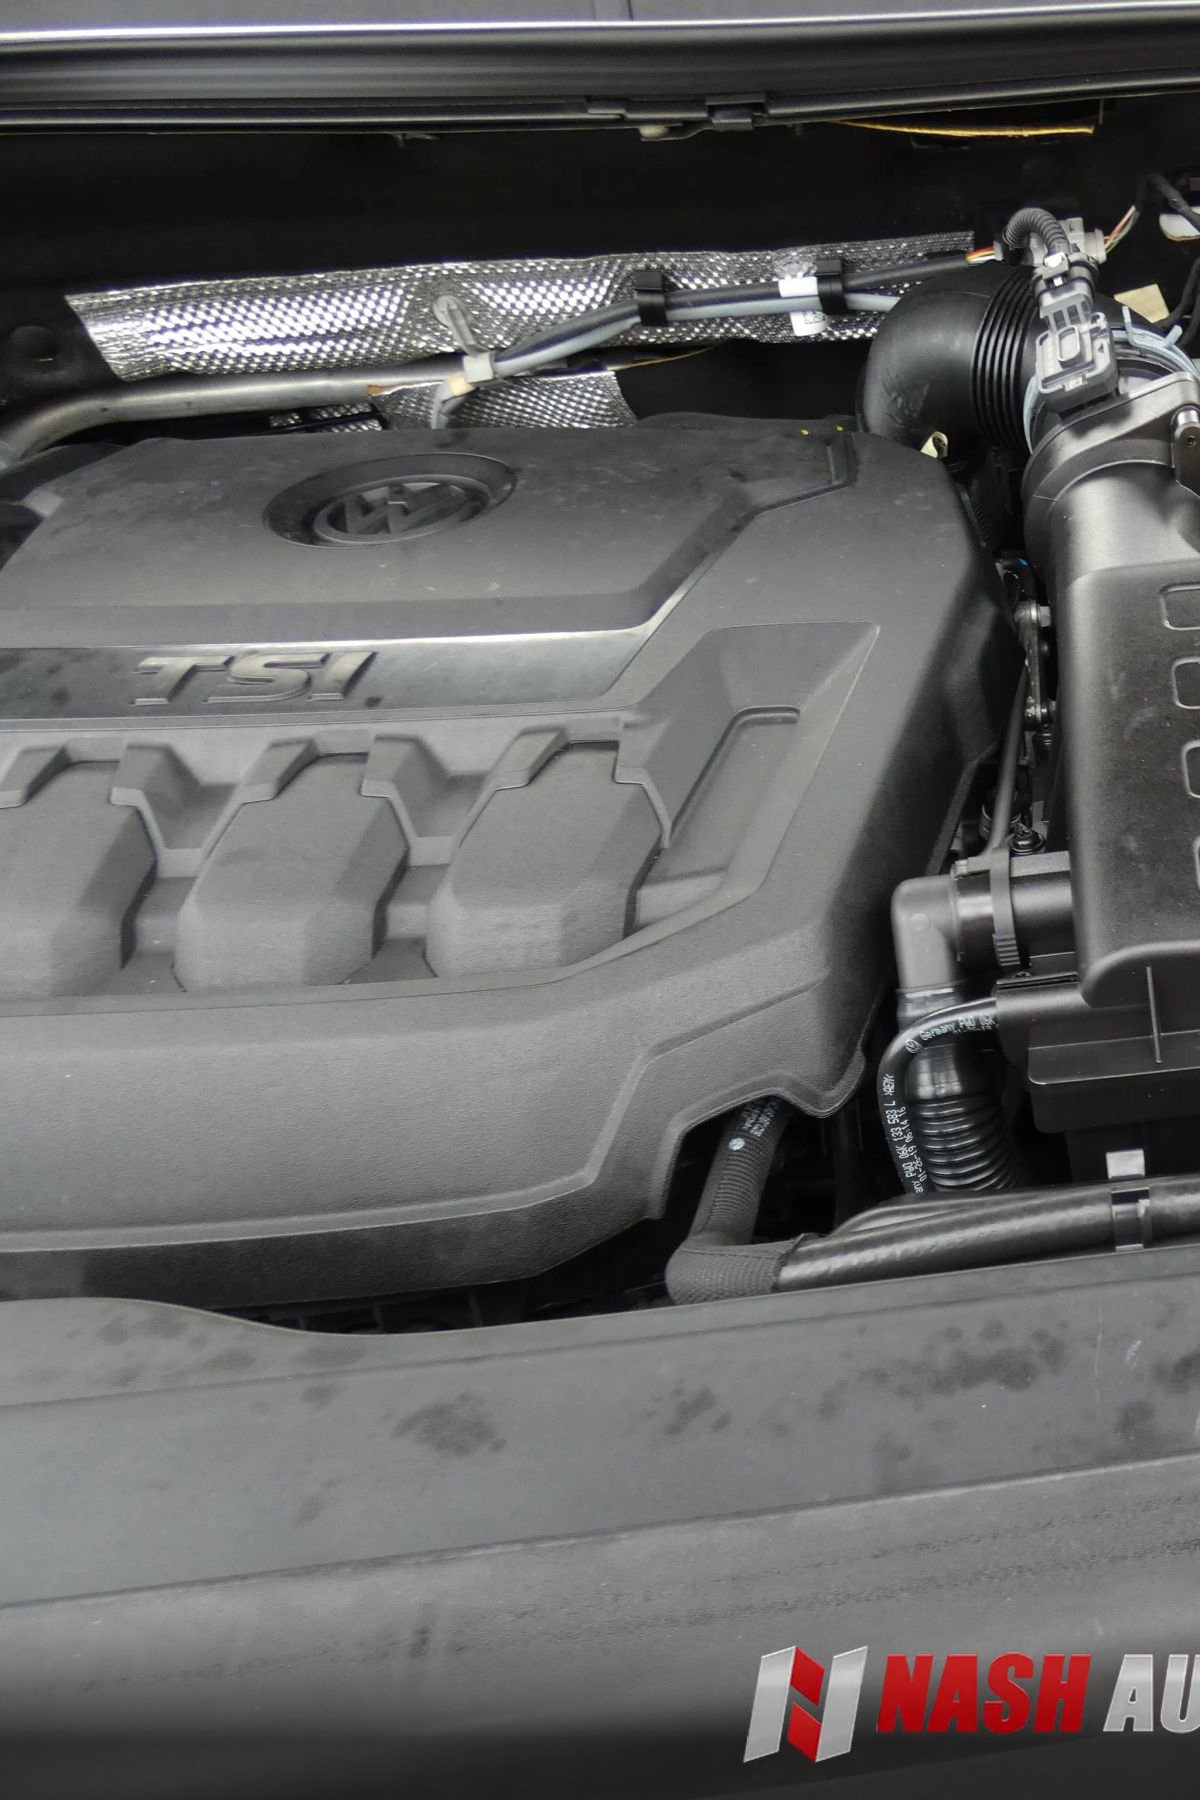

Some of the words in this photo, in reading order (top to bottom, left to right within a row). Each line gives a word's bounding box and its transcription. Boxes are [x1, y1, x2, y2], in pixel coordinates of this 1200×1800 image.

[131, 652, 378, 706] TSI
[885, 1109, 900, 1125] 583
[890, 1126, 904, 1142] 133
